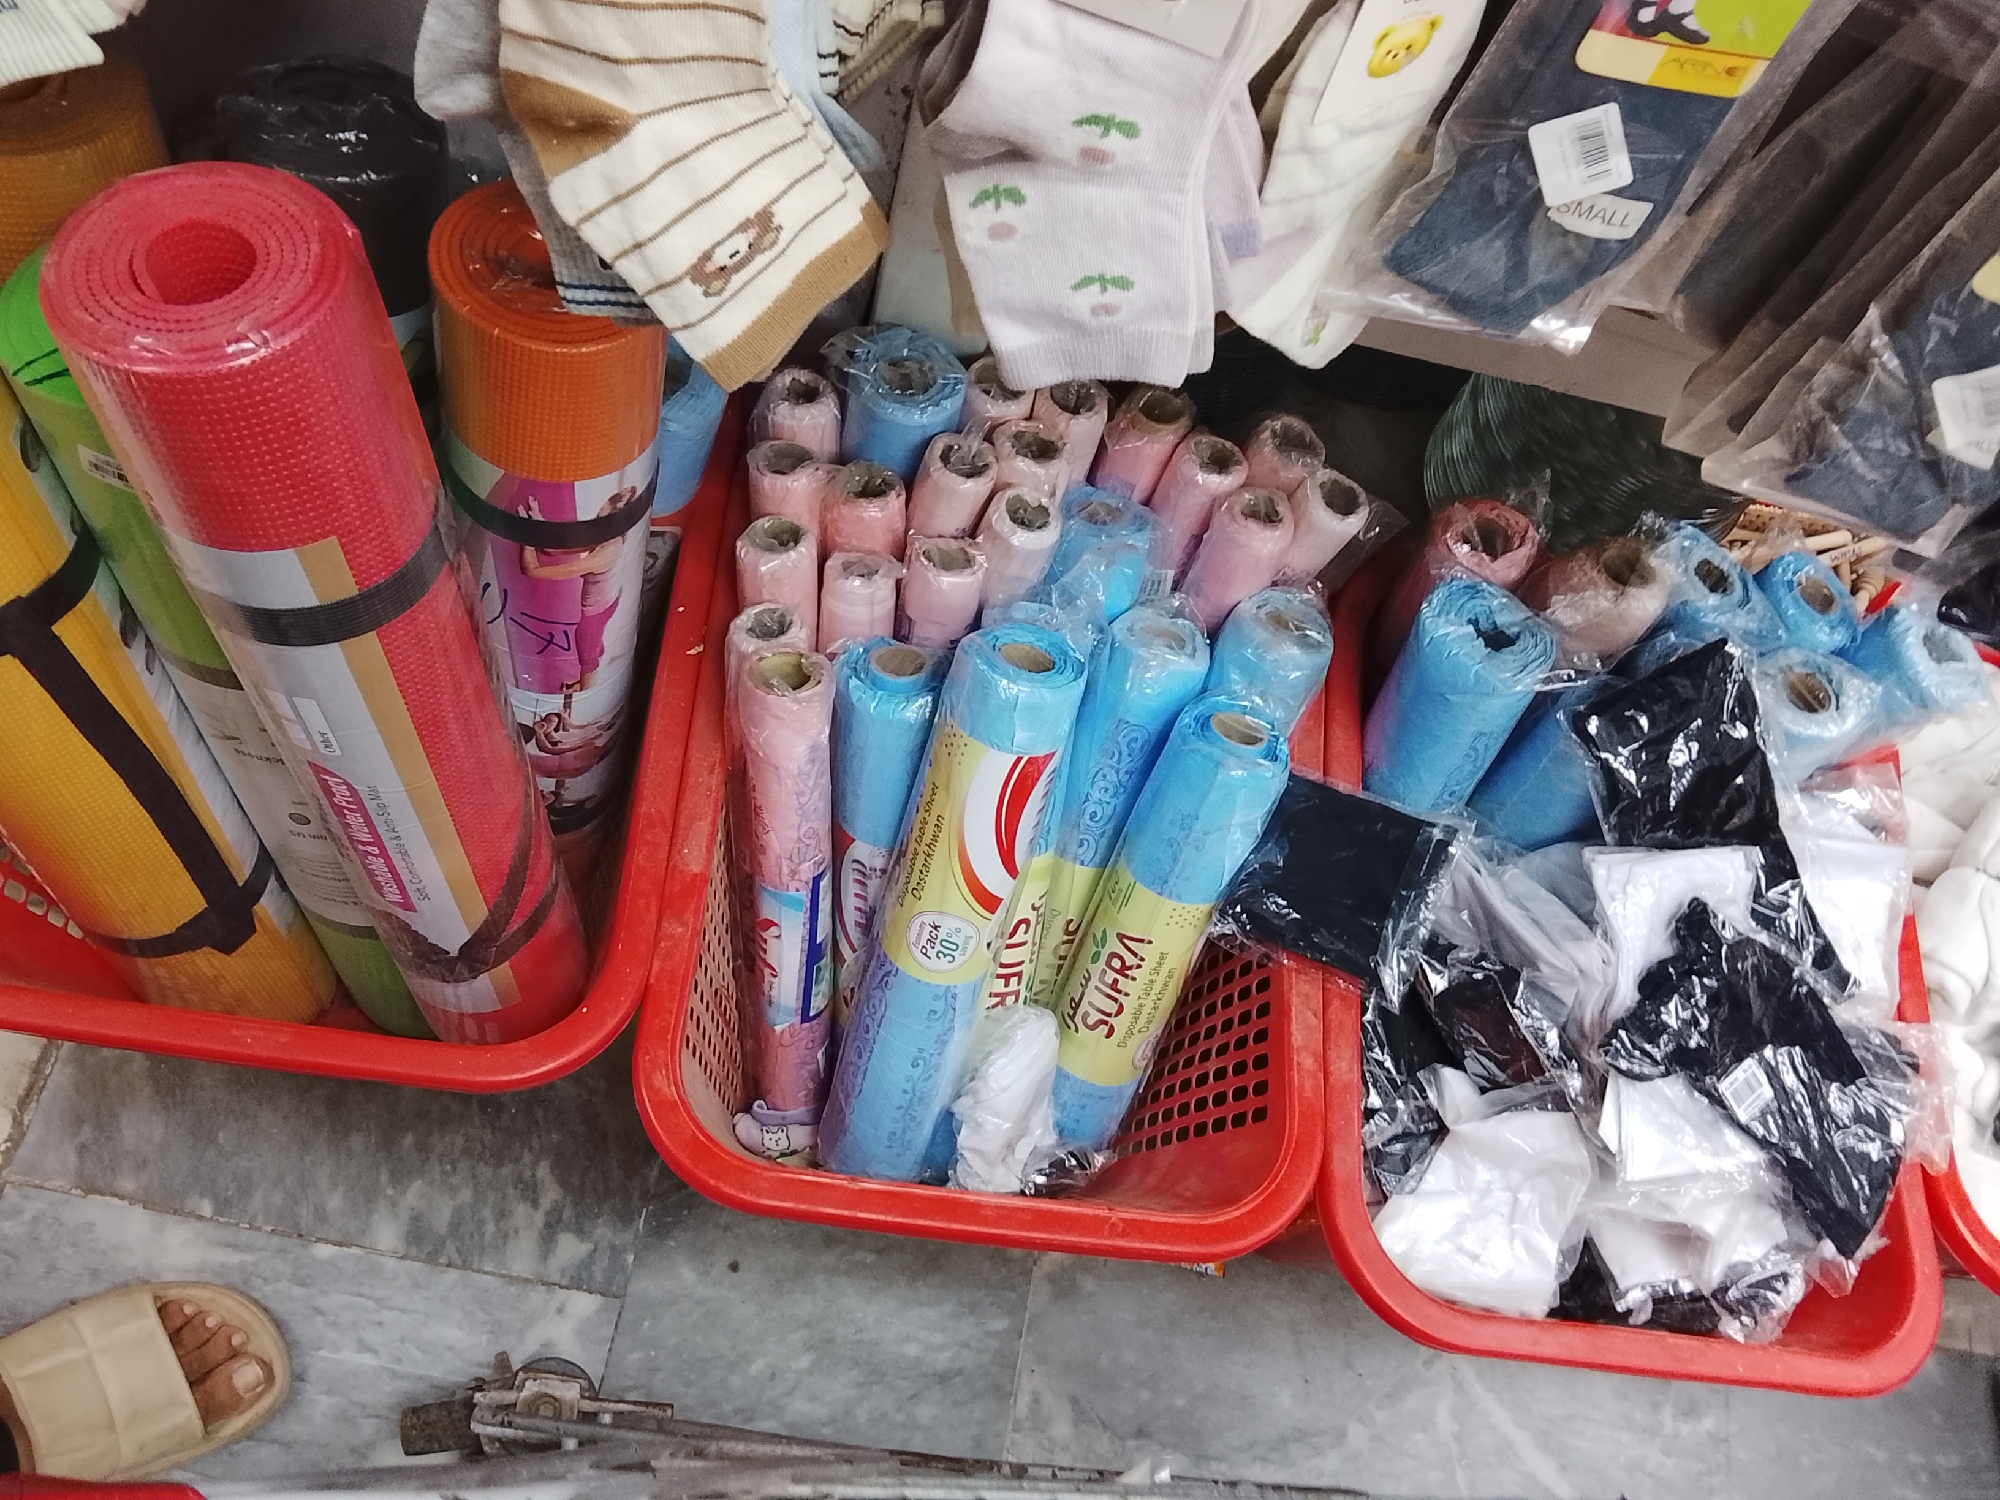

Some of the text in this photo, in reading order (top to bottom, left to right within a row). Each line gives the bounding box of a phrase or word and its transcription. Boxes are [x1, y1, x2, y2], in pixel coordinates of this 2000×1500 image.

[1556, 201, 1630, 228] SMALL
[321, 774, 357, 809] Proof
[366, 785, 382, 801] Mat
[344, 810, 374, 842] Water
[377, 803, 399, 834] Anti-Slip
[358, 845, 380, 855] &
[389, 834, 402, 843] &
[898, 781, 940, 908] Disposable Table Sheet
[395, 842, 423, 885] Comfortable
[910, 814, 946, 901] Dastarkhwan
[367, 856, 404, 903] Washable
[912, 920, 928, 950] Economy
[919, 920, 942, 961] Pack
[935, 926, 962, 964] 30%
[958, 935, 974, 957] saving
[1081, 932, 1154, 1039] SUFRA
[1117, 951, 1170, 1049] Disposable Table Sheet
[1138, 967, 1178, 1034] Dastarkhwan
